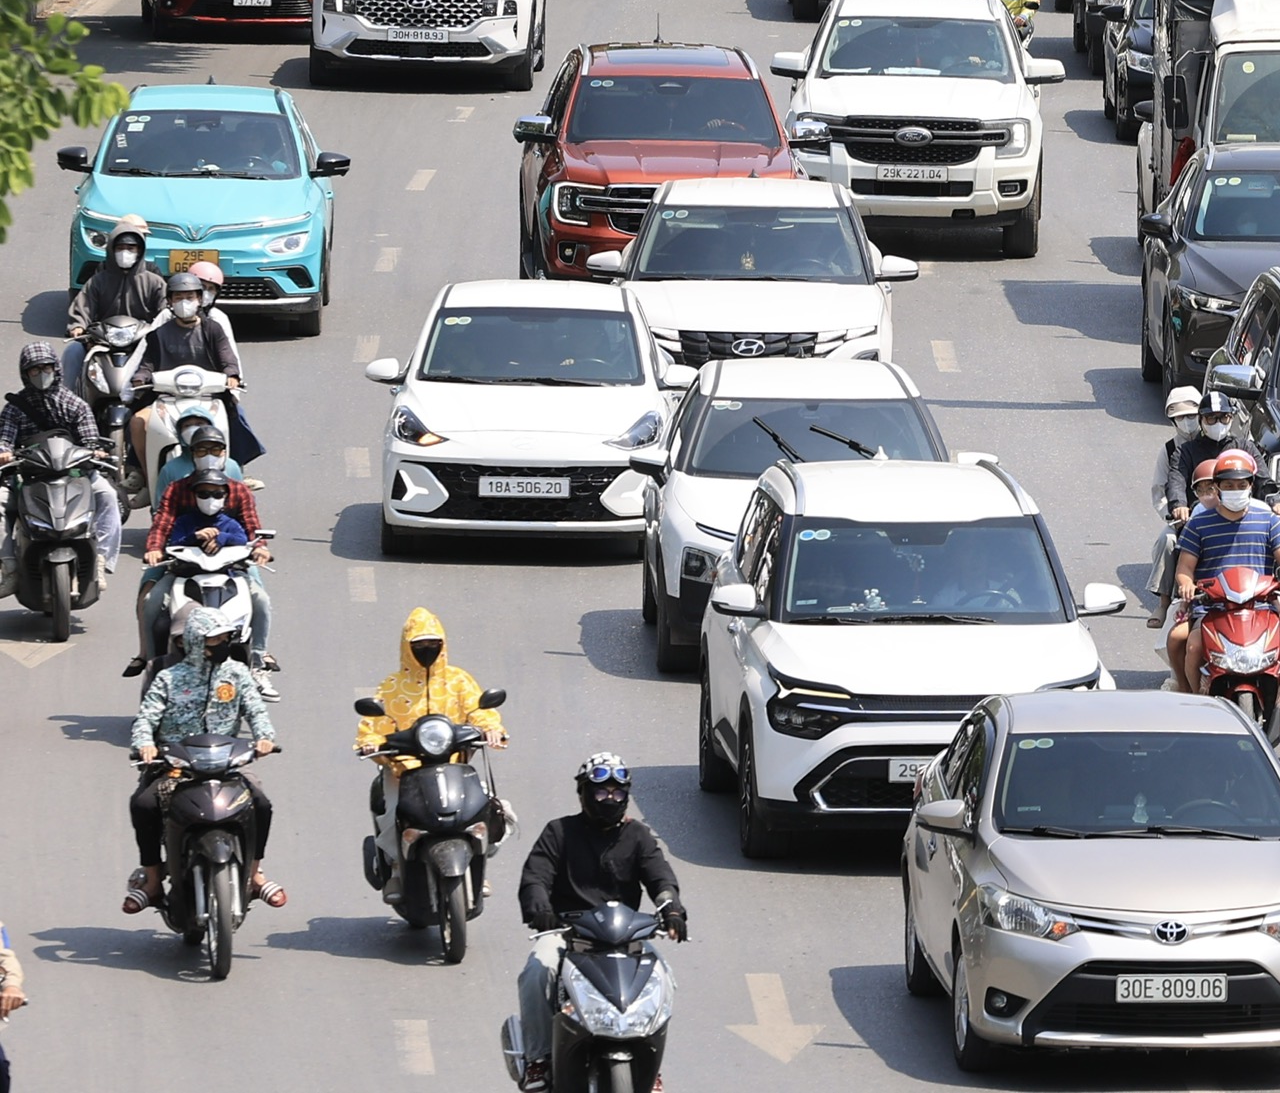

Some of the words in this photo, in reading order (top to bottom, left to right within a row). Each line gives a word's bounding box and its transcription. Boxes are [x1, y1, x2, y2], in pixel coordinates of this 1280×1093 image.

[392, 31, 444, 40] 30H-818.93
[904, 131, 923, 141] Ford
[883, 168, 942, 179] 29K-221.04
[183, 251, 205, 261] 29E
[488, 481, 562, 494] 18A-506.20
[1119, 978, 1223, 999] 30E-809.06
